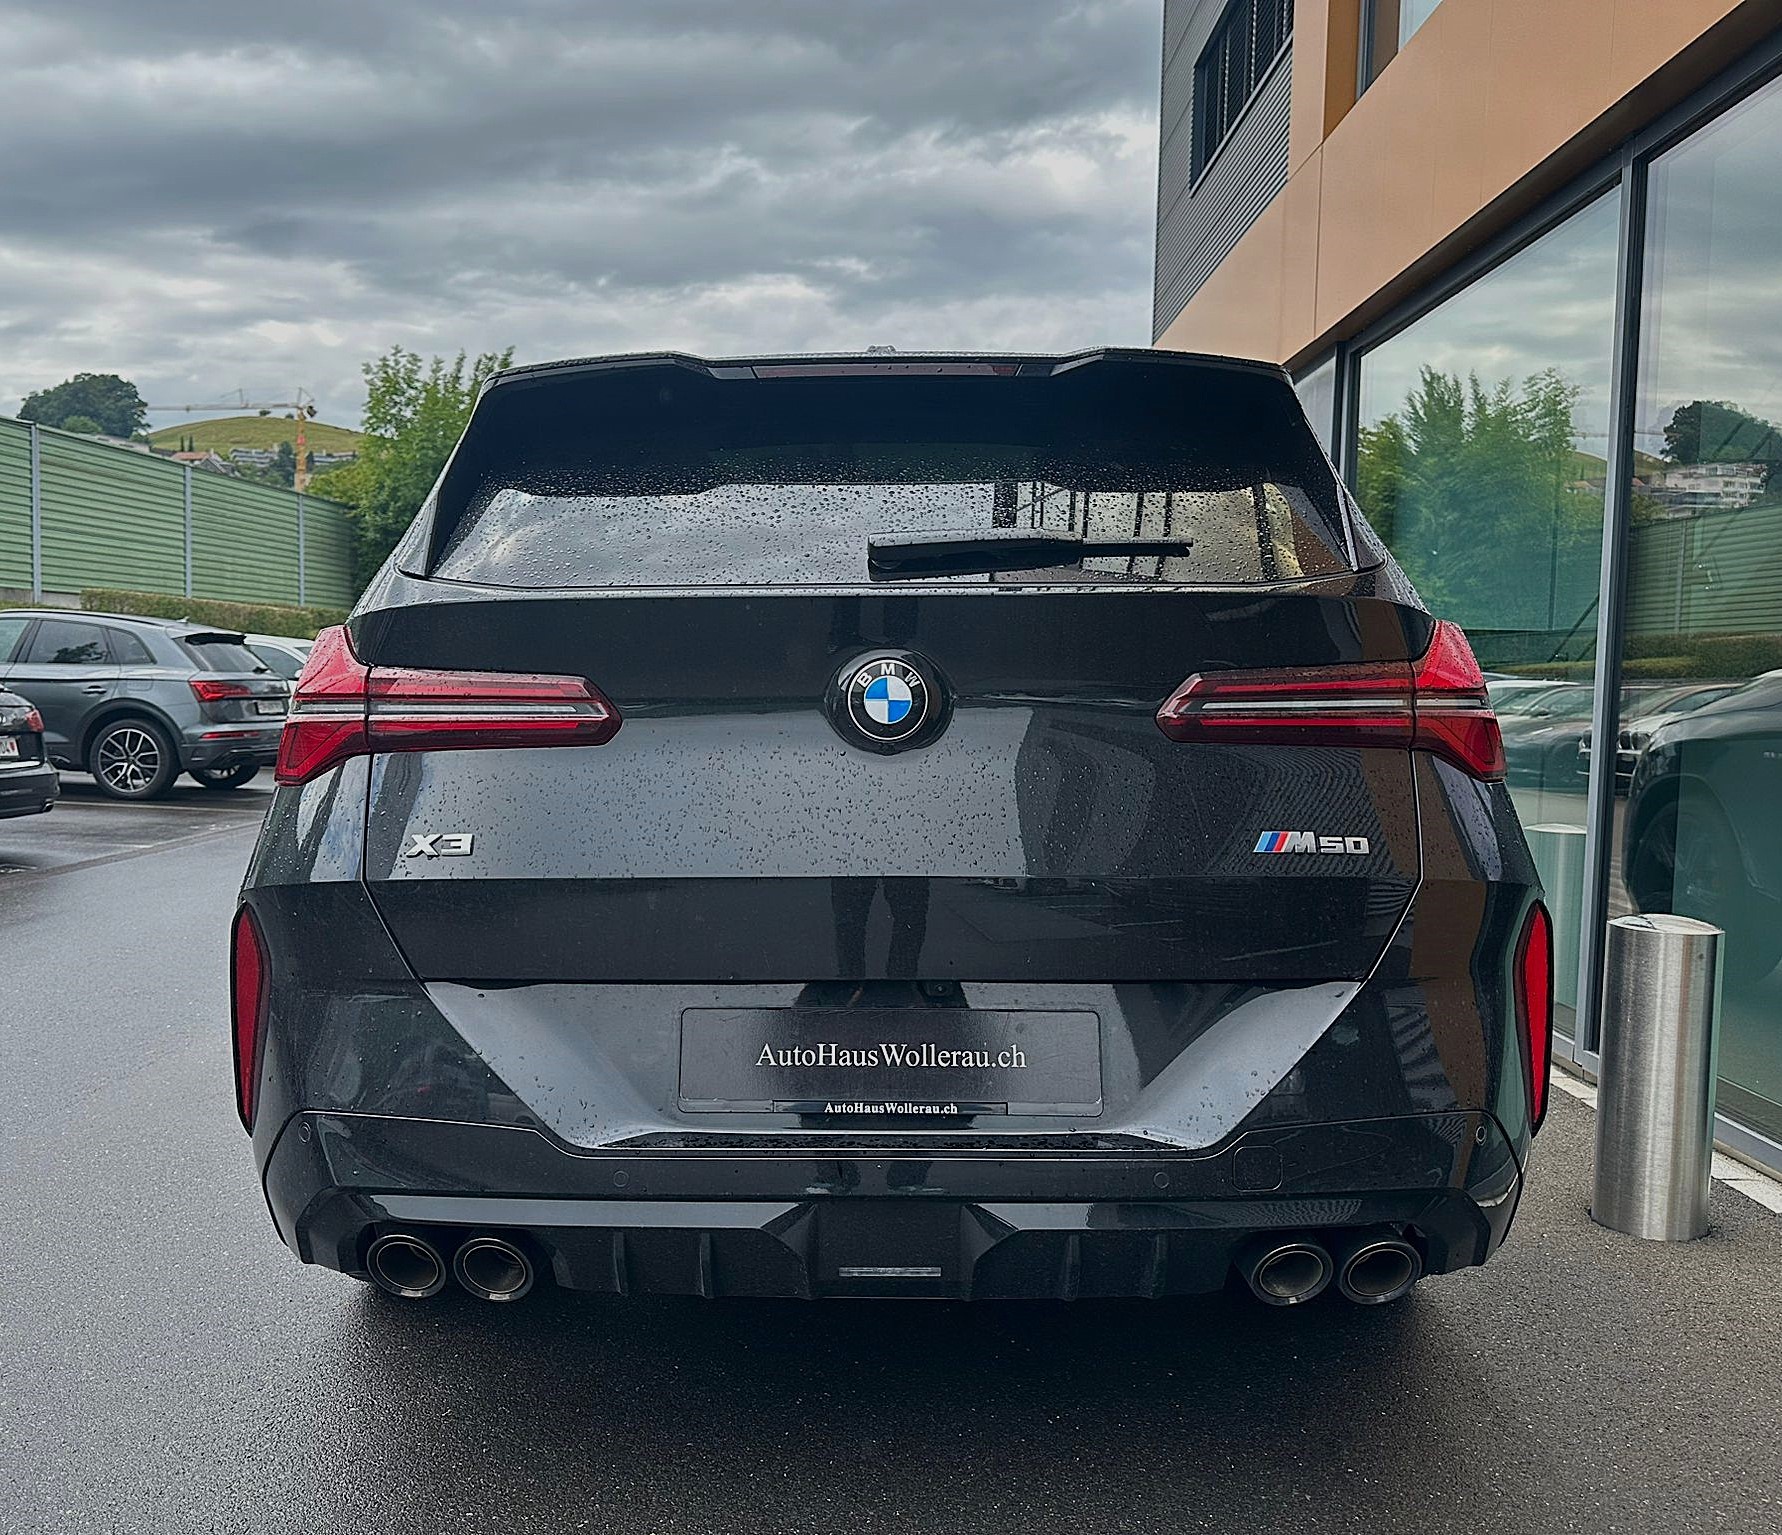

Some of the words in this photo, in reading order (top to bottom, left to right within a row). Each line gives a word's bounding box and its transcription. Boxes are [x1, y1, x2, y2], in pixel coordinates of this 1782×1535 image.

[856, 663, 921, 689] BMW
[405, 834, 474, 858] X3
[1279, 831, 1370, 854] M50
[755, 1043, 1027, 1068] AutoHausWollerau.ch
[824, 1102, 958, 1114] AutoHausWollerau.ch
